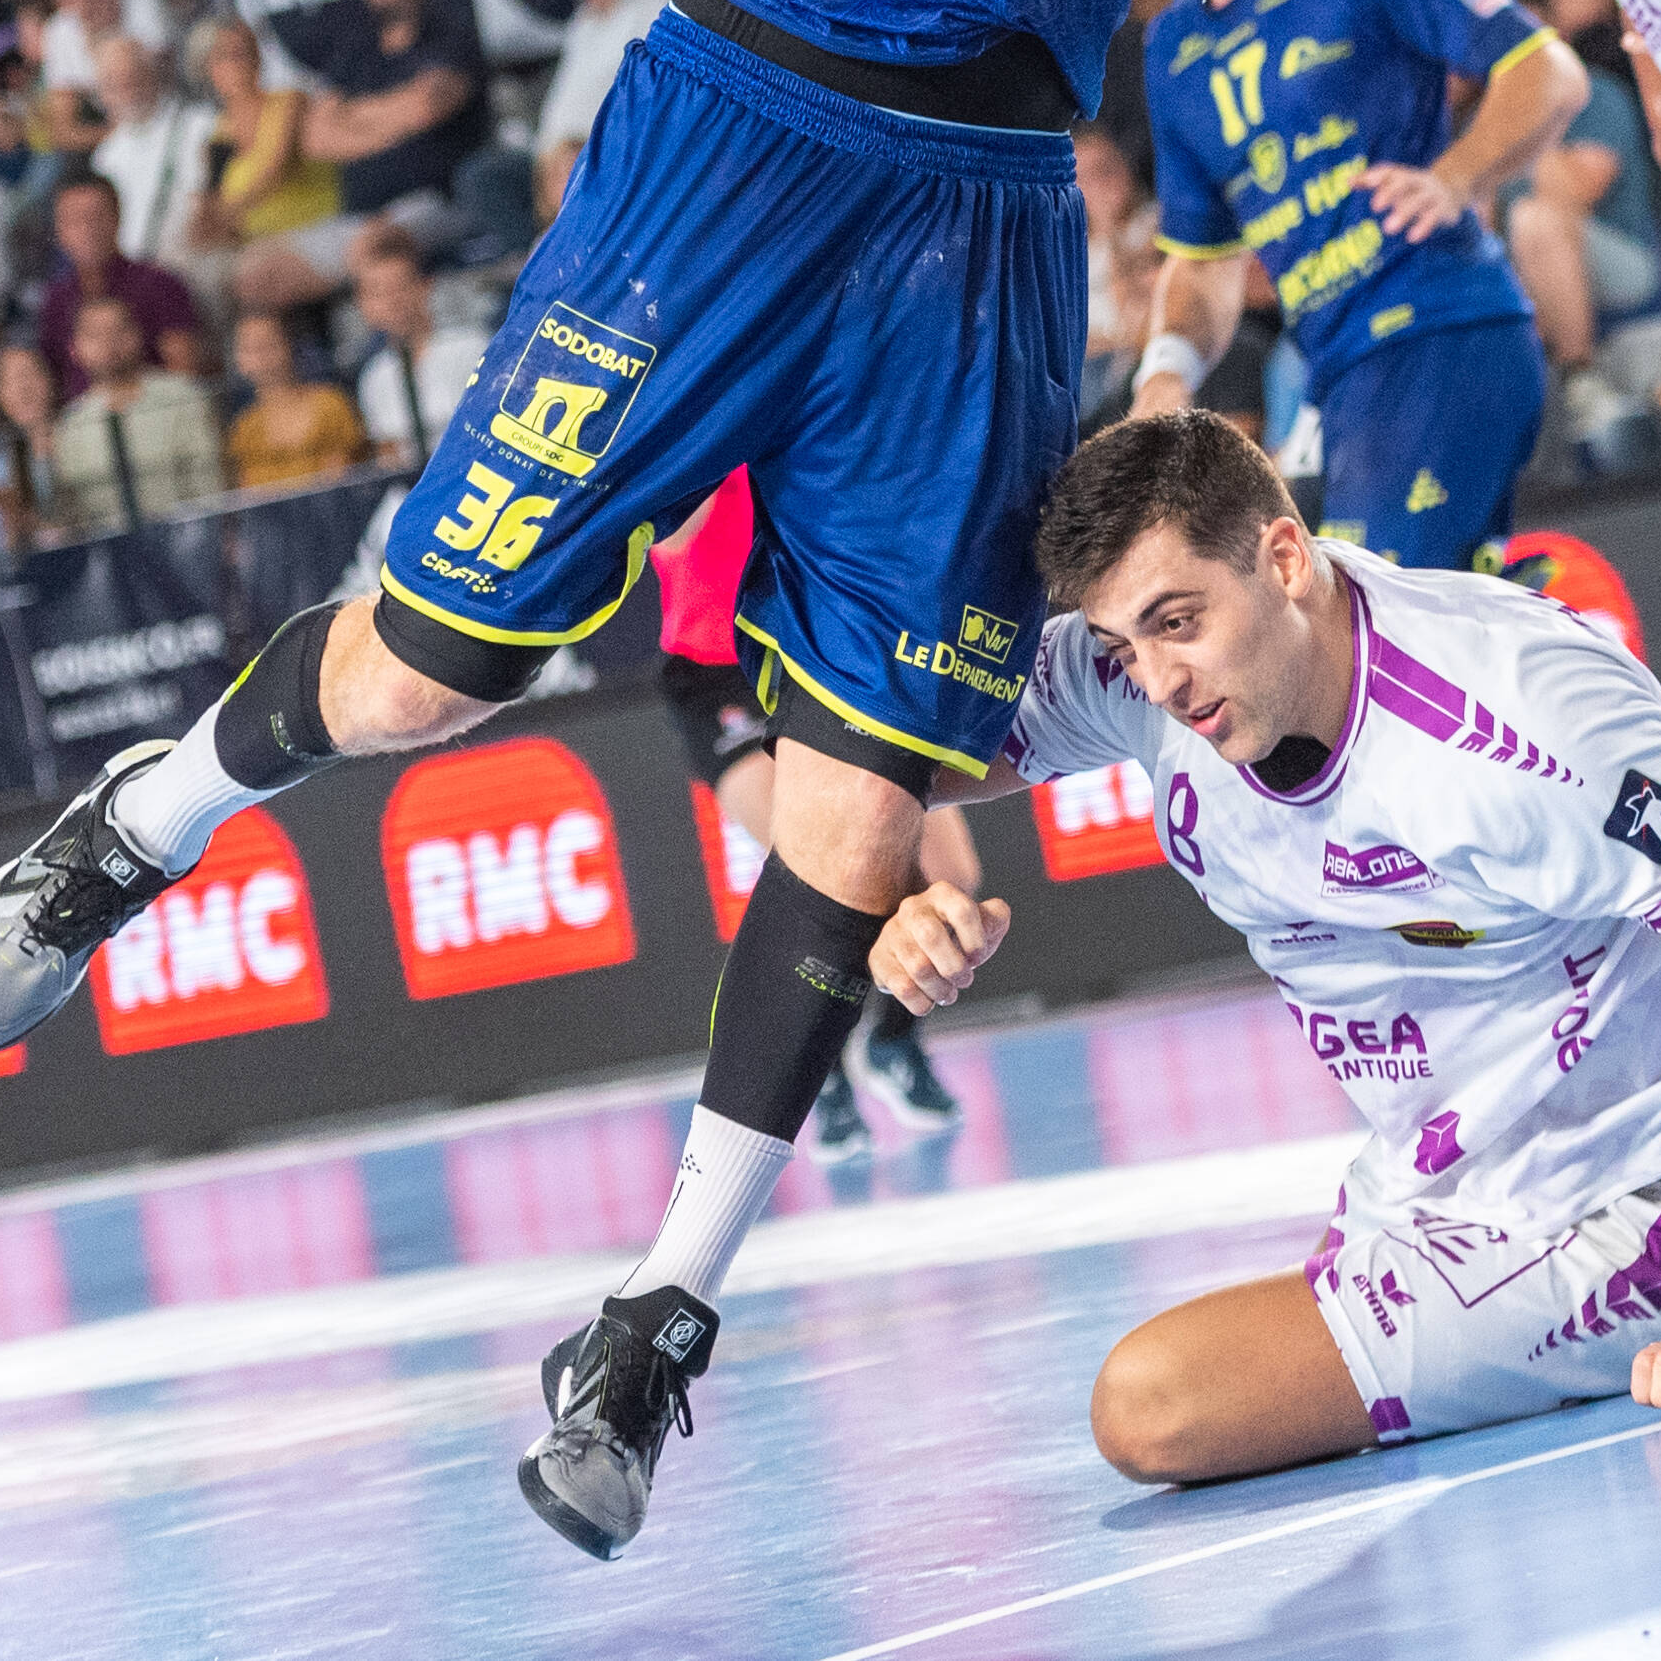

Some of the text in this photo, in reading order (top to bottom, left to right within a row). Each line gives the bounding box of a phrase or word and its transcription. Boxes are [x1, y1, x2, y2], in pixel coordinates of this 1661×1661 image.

[1208, 38, 1268, 148] 17
[538, 317, 647, 380] SODOBAT
[433, 459, 562, 572] 36
[421, 551, 482, 587] CRAFT
[403, 810, 612, 956] RMC
[1324, 849, 1418, 883] ABALONE
[106, 869, 307, 1017] RMC
[1351, 1273, 1398, 1339] erima
